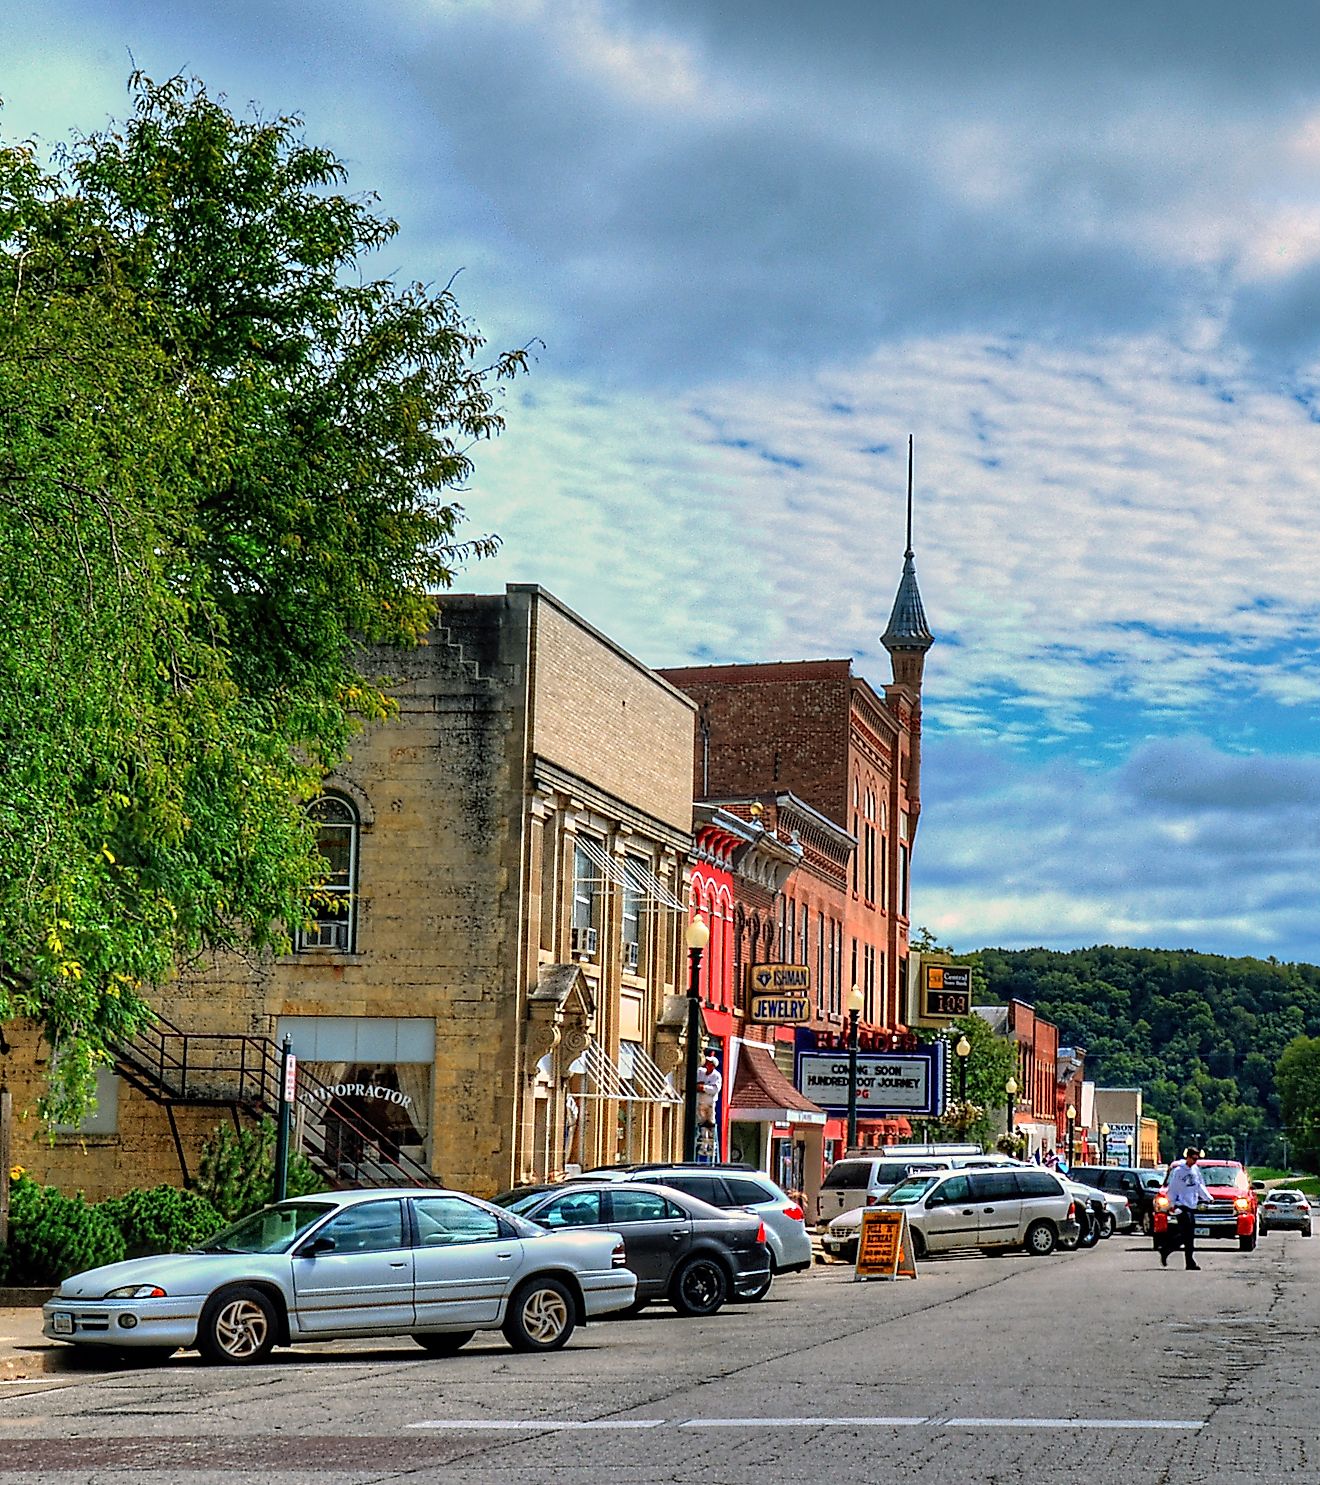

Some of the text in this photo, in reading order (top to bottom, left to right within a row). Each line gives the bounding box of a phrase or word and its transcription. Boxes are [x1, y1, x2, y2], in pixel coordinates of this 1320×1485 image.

[773, 970, 807, 986] ISHMAN
[943, 972, 968, 981] Central
[754, 1000, 806, 1018] JEWELRY
[874, 1065, 902, 1076] SOON
[807, 1075, 920, 1089] HUNDRED OOT JOURNEY
